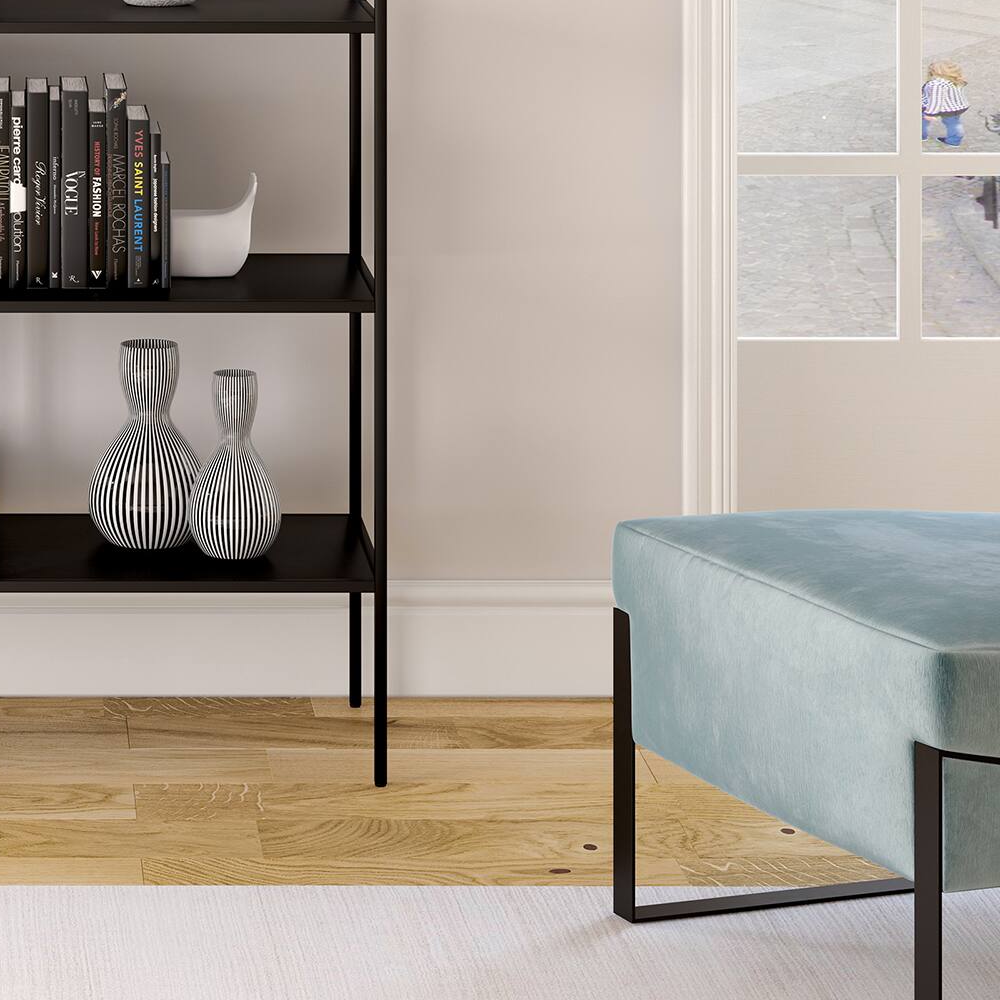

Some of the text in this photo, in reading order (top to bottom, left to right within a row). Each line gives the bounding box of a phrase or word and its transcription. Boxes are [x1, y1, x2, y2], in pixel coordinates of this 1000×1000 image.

[11, 117, 22, 154] pierre
[134, 130, 143, 158] YVES
[34, 161, 47, 225] Roger Vivier
[64, 170, 85, 216] IN VOGUE
[92, 177, 102, 217] FASHION
[134, 161, 143, 195] SAINT
[112, 153, 126, 253] MARCEL ROCHAS
[134, 199, 143, 252] LAURENT
